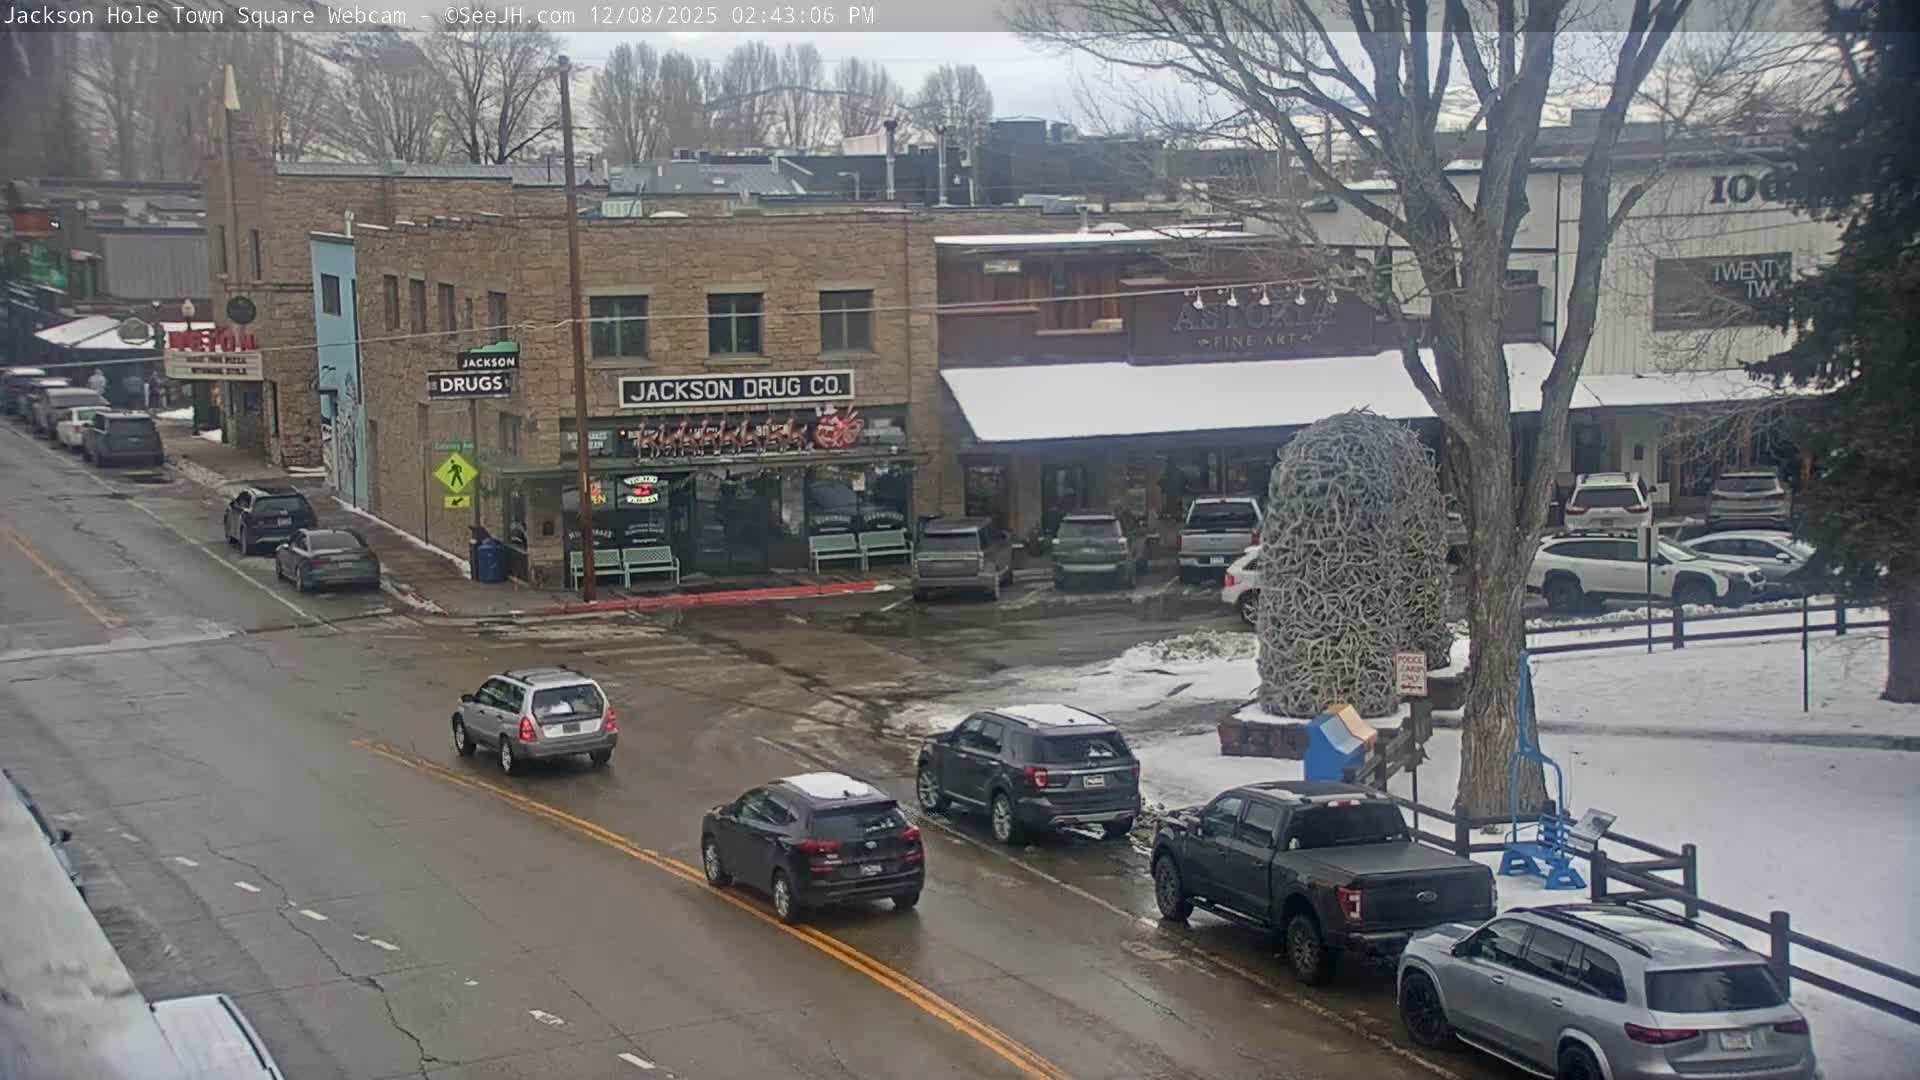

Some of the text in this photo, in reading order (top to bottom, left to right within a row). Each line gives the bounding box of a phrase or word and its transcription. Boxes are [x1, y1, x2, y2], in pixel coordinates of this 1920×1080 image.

[1712, 259, 1789, 282] TWENTY
[1213, 333, 1297, 347] FINE ART
[462, 357, 516, 369] JACKSON
[439, 376, 503, 393] DRUGS
[630, 375, 843, 402] JACKSON DRUG CO.
